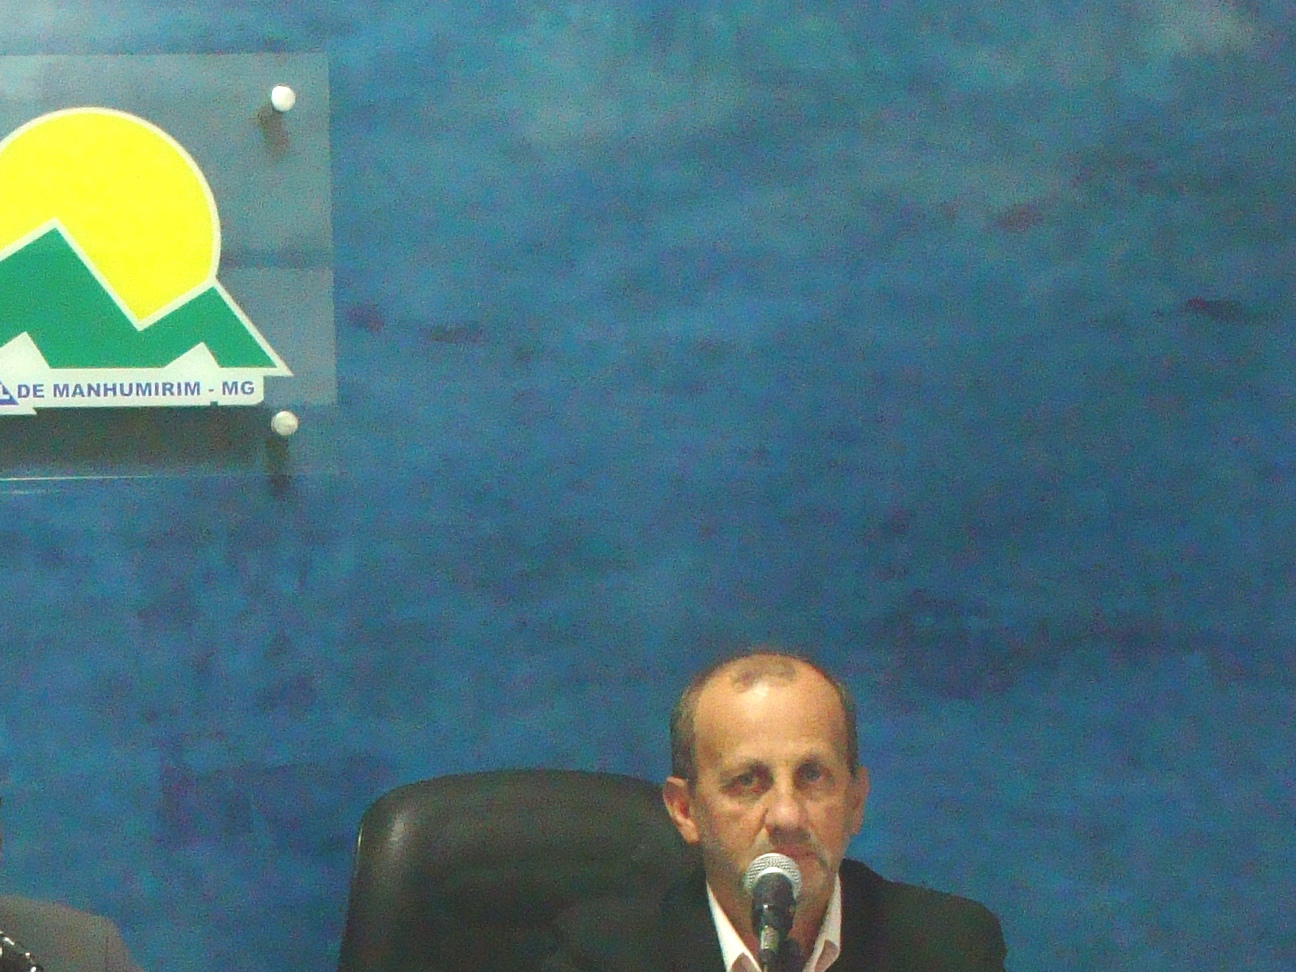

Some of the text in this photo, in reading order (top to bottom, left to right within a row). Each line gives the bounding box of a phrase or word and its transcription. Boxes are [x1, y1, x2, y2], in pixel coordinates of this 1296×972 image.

[17, 384, 45, 398] DE
[53, 381, 201, 398] MANHUMIRIM
[222, 380, 255, 396] MG
